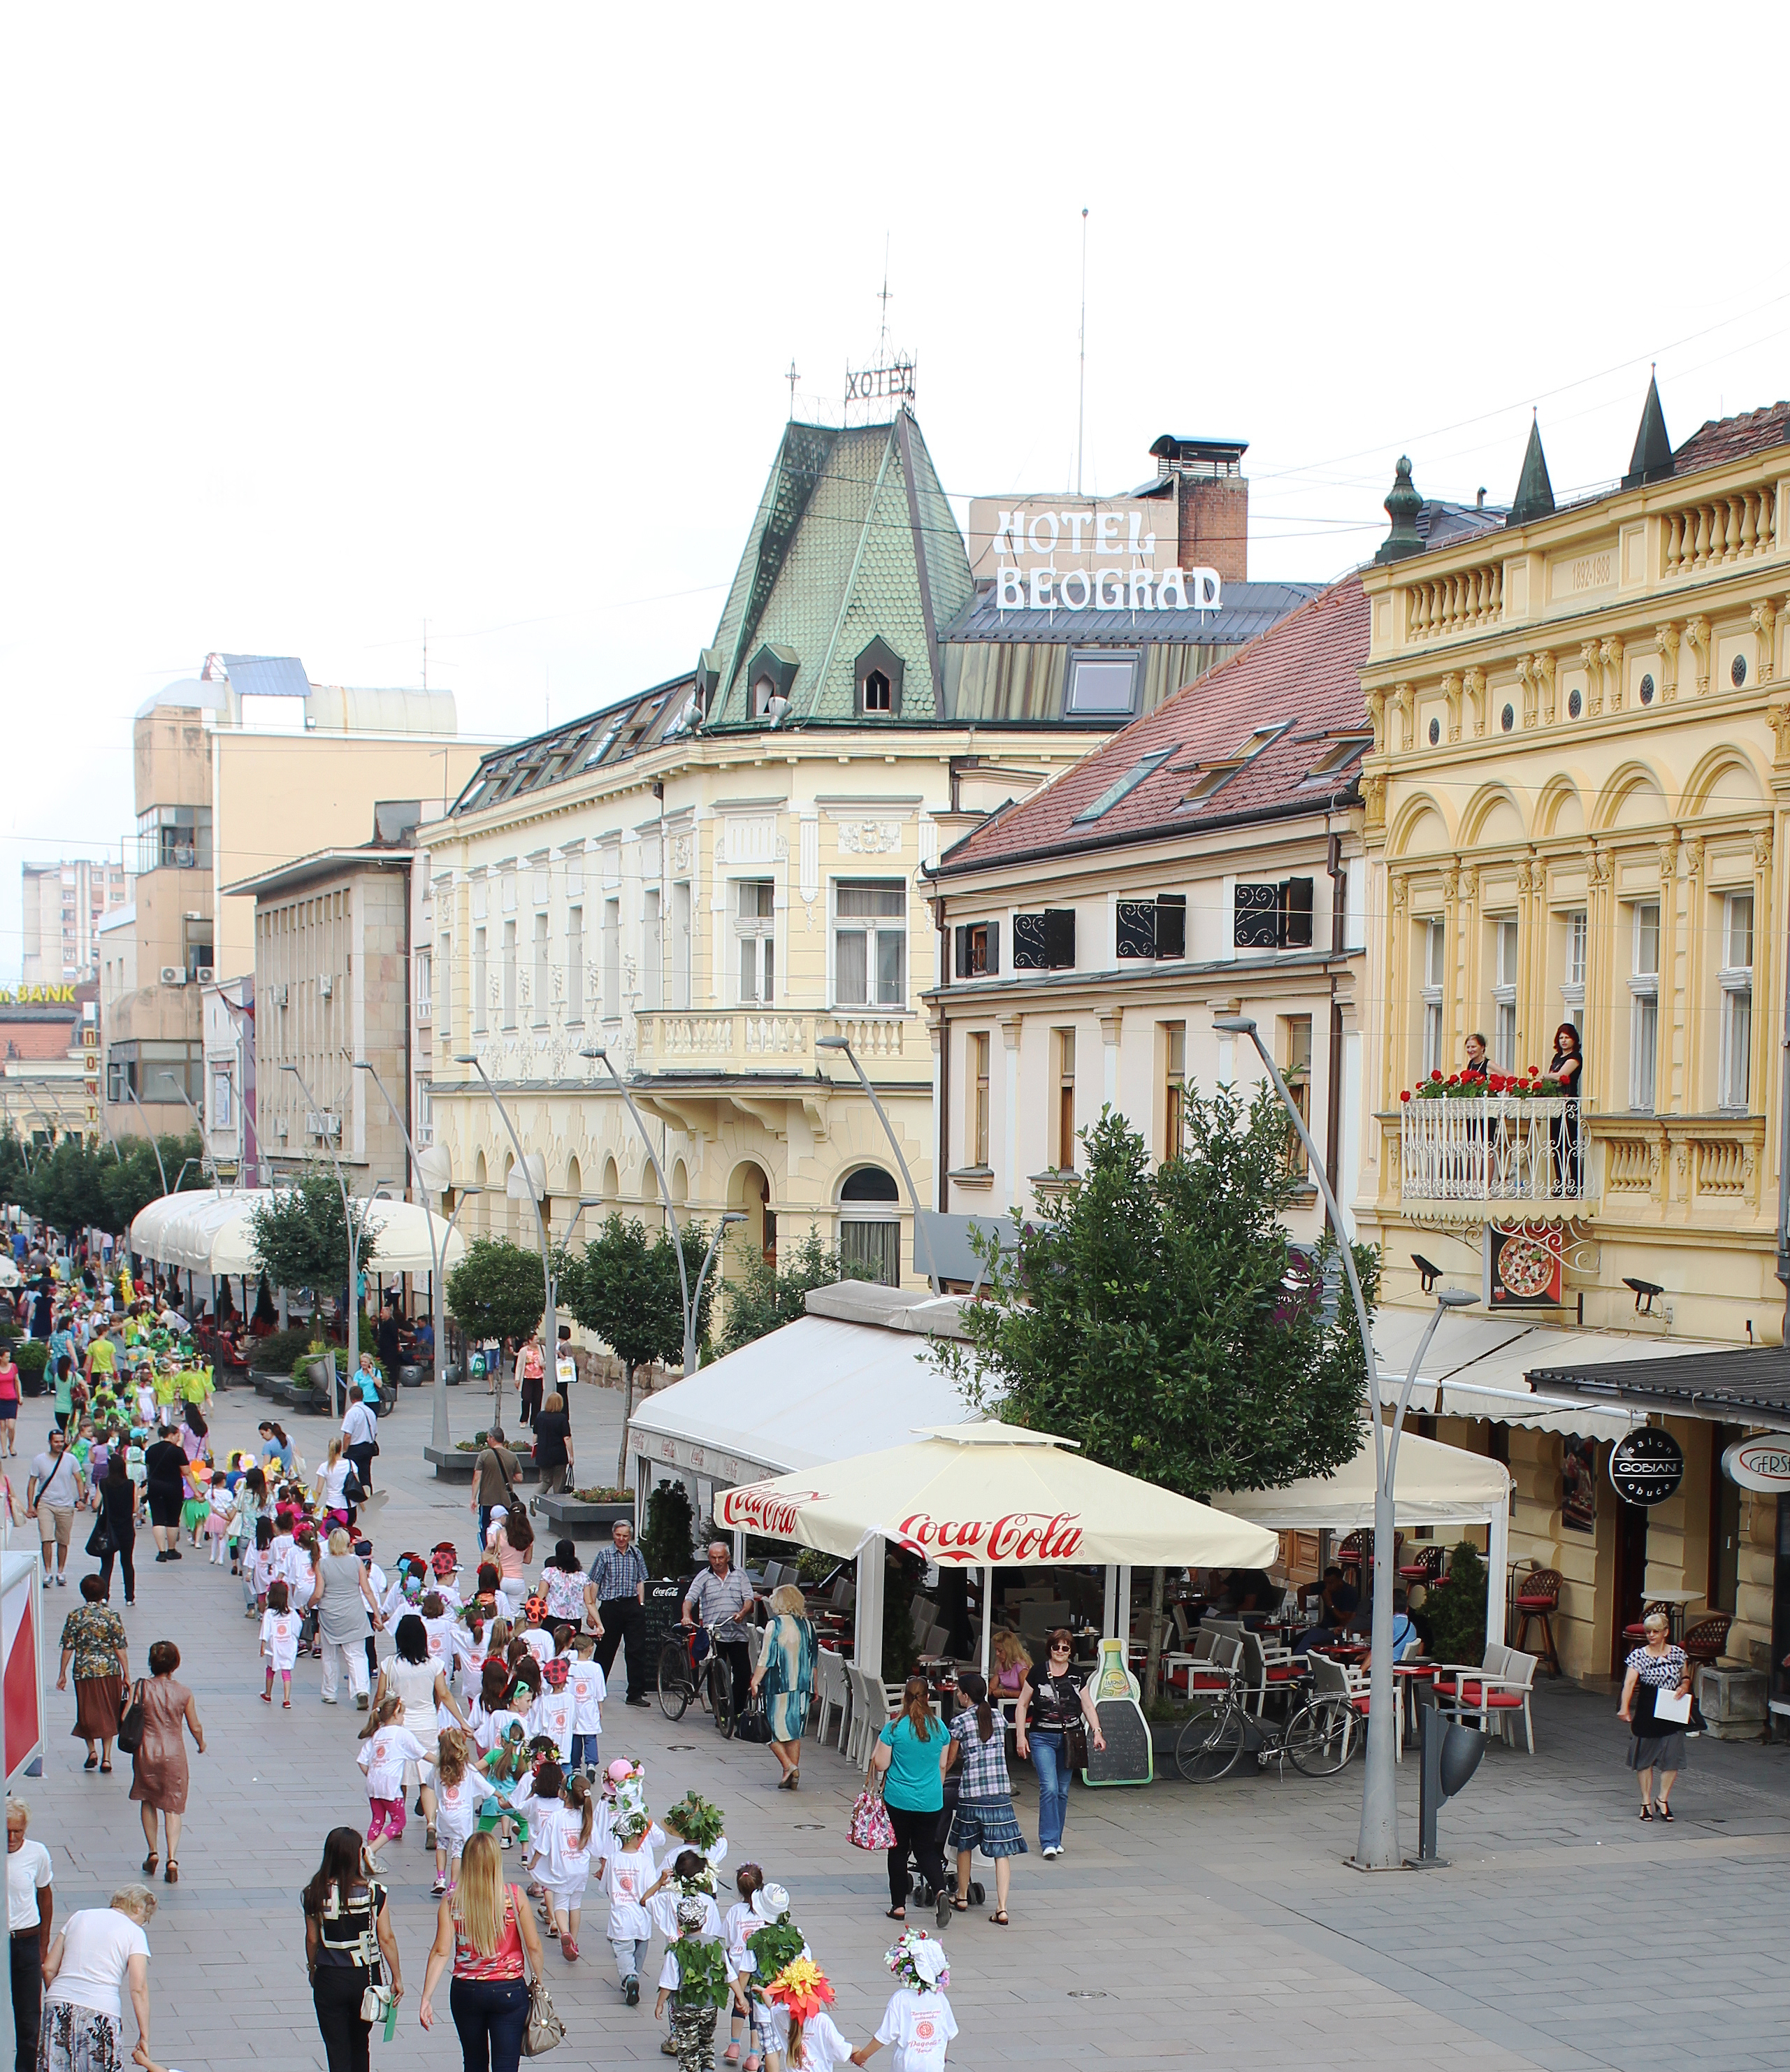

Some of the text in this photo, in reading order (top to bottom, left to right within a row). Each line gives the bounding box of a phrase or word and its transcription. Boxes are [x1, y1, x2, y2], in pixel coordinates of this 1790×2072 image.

[993, 510, 1156, 554] HOTEL
[996, 567, 1223, 610] BEOGRAD
[1572, 554, 1610, 591] 1892-1988
[16, 984, 77, 1003] BANK
[1627, 1437, 1671, 1454] salon
[724, 1483, 835, 1534] Coca-Cola
[899, 1512, 1083, 1562] Coca-Cola
[652, 1587, 679, 1597] Coca-Cola
